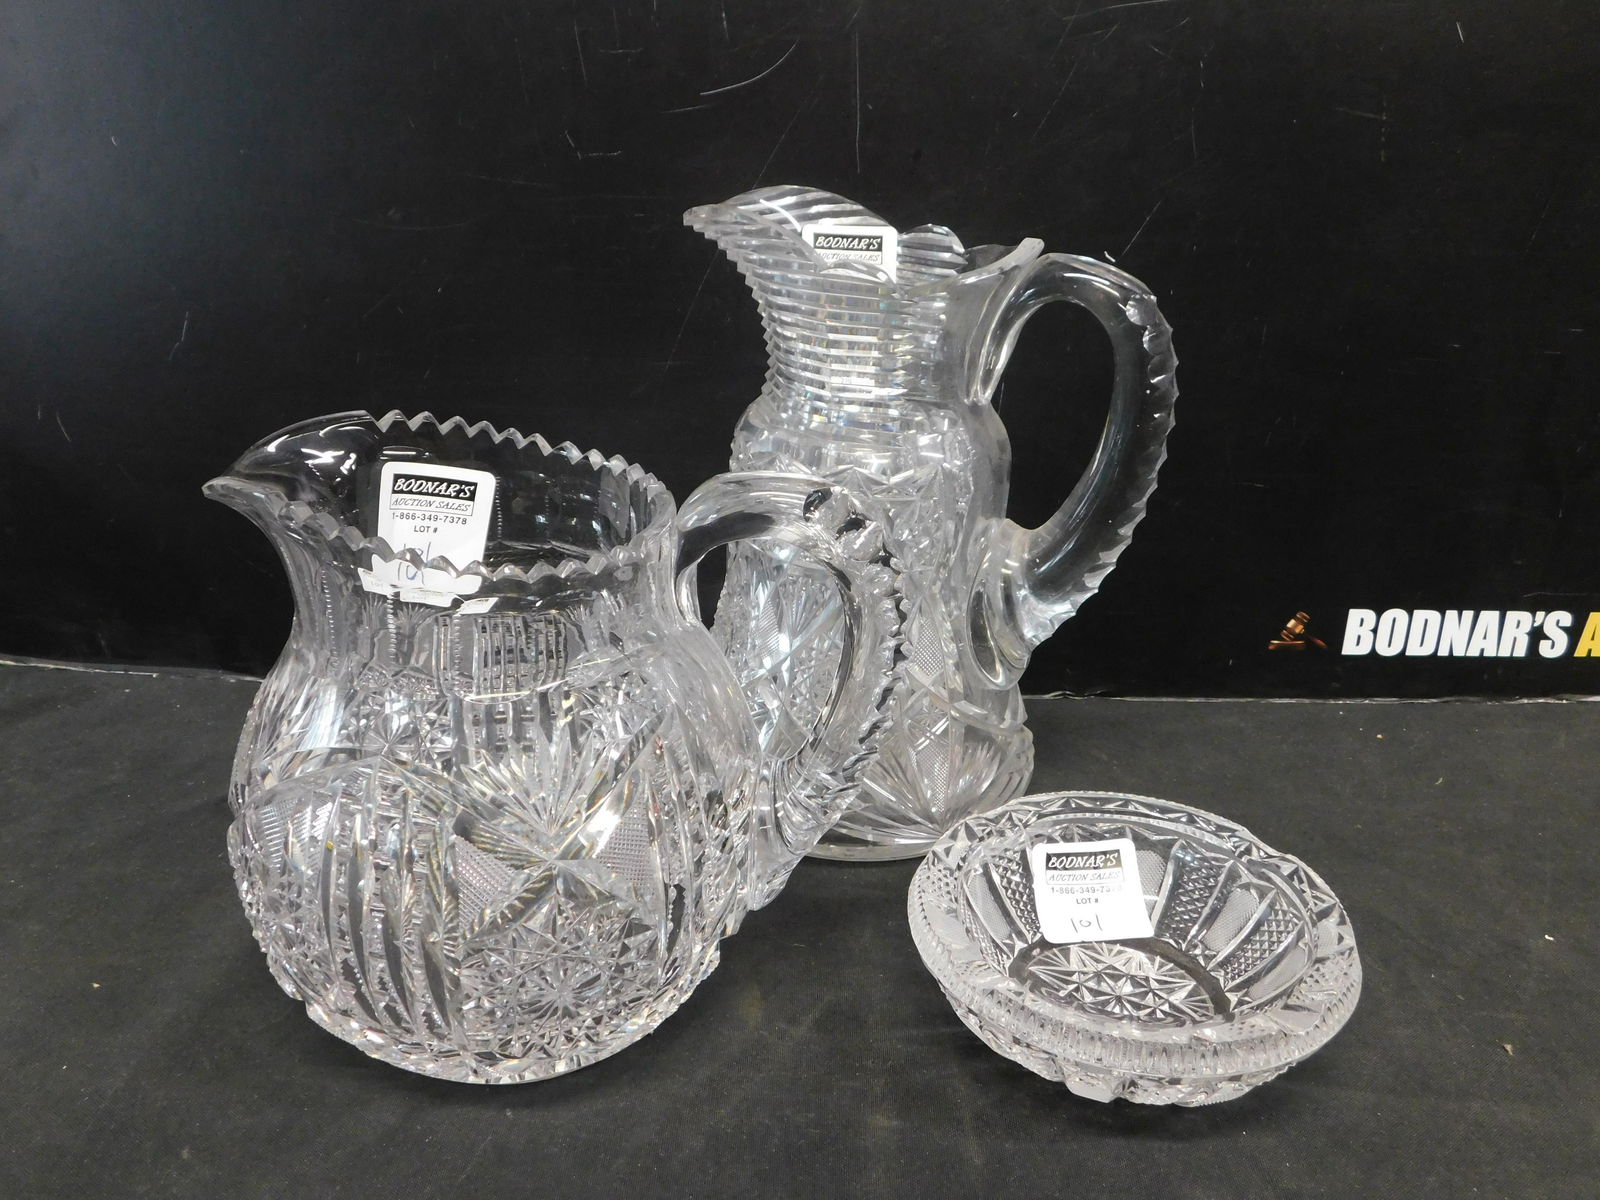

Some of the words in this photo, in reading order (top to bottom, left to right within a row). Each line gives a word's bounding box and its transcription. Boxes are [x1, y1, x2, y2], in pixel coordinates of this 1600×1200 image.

[815, 236, 881, 249] BODNAR'S
[393, 478, 475, 497] BODNAR'S
[392, 498, 435, 508] AUCTION
[435, 501, 471, 512] SALES
[391, 512, 468, 524] 1-866-349-7378
[413, 525, 431, 533] LOT
[1341, 608, 1573, 658] BODNAR'S
[1048, 853, 1118, 868] BODNAR'S
[1049, 872, 1089, 882] AUCTION
[1090, 870, 1120, 881] SALES
[1070, 913, 1103, 934] 101
